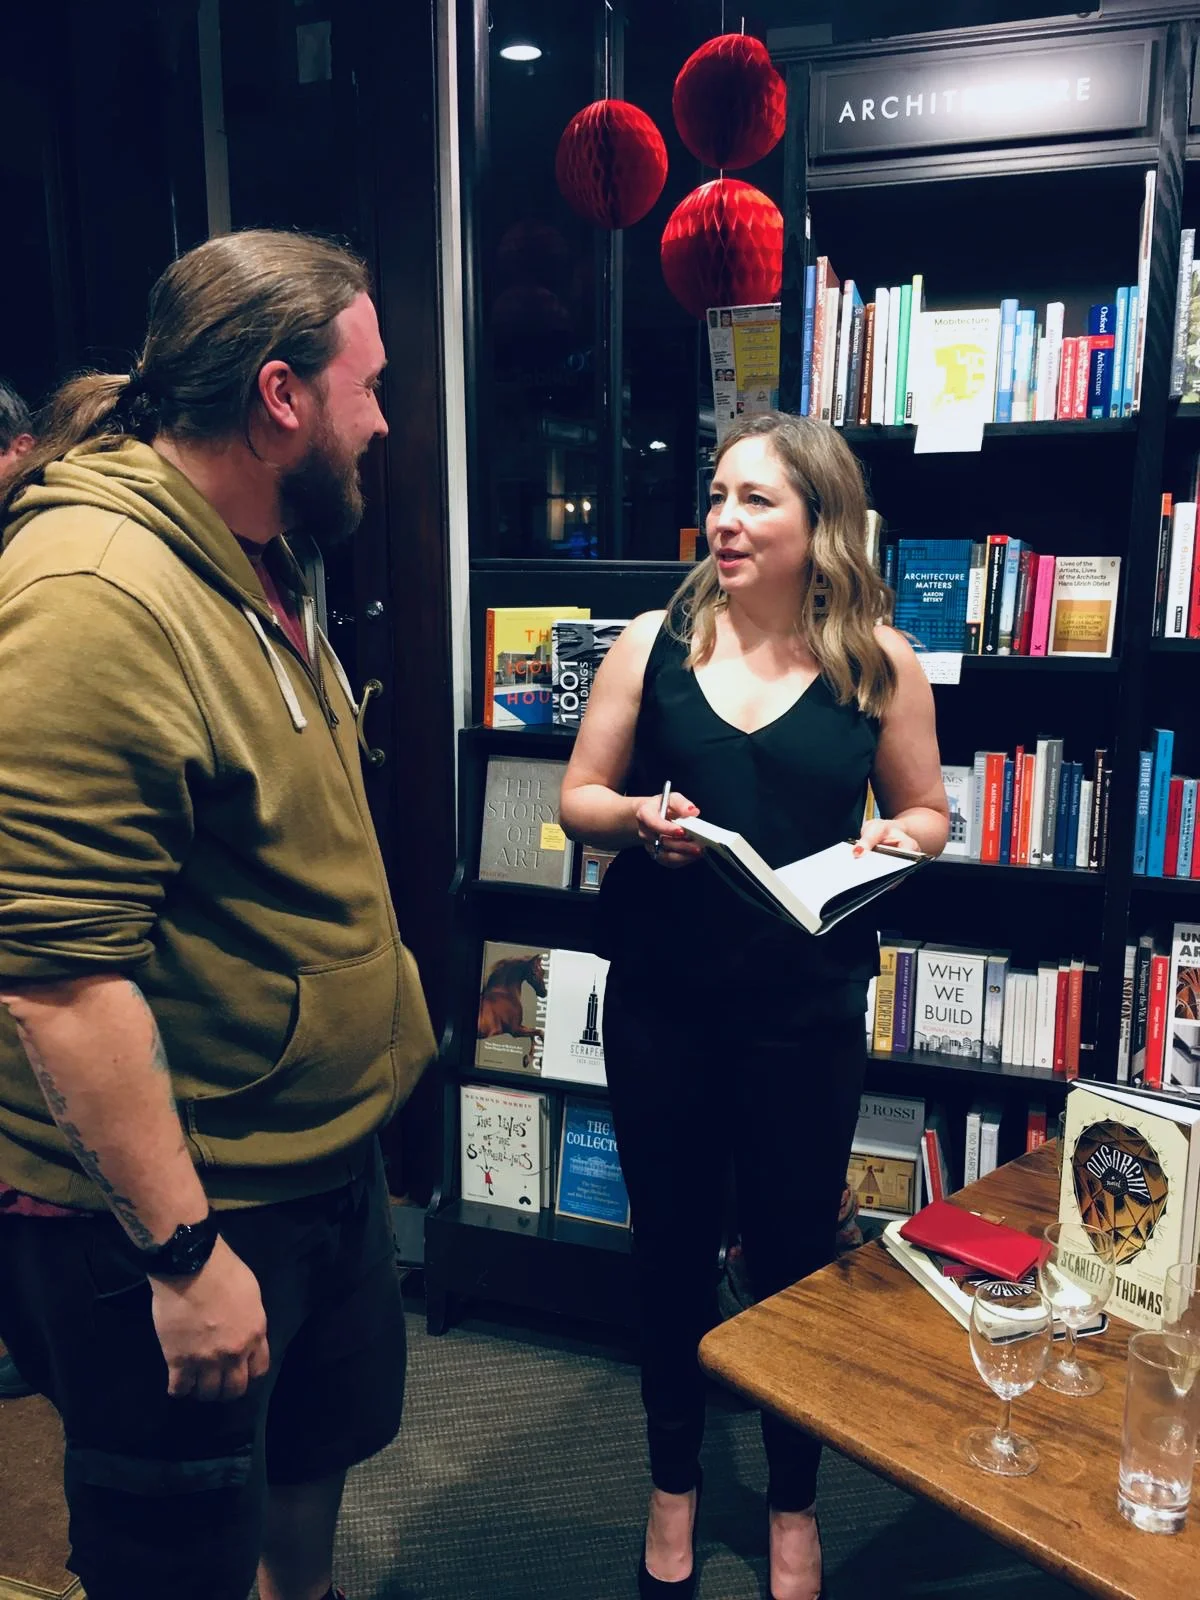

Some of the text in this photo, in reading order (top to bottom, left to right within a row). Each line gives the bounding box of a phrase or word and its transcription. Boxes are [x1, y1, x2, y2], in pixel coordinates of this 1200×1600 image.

[838, 77, 1091, 124] ARCHITE
[934, 317, 990, 326] Mobitecture
[1099, 306, 1109, 335] Oxford
[852, 317, 862, 354] architecture
[863, 360, 871, 394] ARCHITECTURE
[1095, 351, 1105, 396] Architecture
[904, 573, 965, 581] ARCHITECTURE
[915, 581, 953, 590] MATTERS
[971, 571, 981, 620] ARCHITECTURE
[525, 629, 550, 643] TH
[507, 690, 550, 705] HOU
[560, 661, 579, 723] 1001
[1140, 758, 1151, 787] FUTURE
[505, 778, 545, 800] THE
[1047, 767, 1058, 815] Architectural Styles
[487, 801, 560, 824] STORY
[1139, 790, 1150, 816] CITIES
[989, 804, 997, 832] EMOTIONS
[507, 823, 538, 845] OF
[495, 847, 544, 869] ART
[928, 962, 973, 983] WHY
[934, 985, 964, 1003] WE
[1121, 978, 1134, 1020] ISOKON
[1137, 960, 1149, 1023] Designing the V&A
[877, 989, 893, 1038] CONCRETOPIA
[925, 1005, 973, 1025] BUILD
[465, 1094, 500, 1104] DESMOND
[474, 1114, 492, 1128] THE
[873, 1103, 915, 1120] ROSSI
[587, 1119, 610, 1135] THE
[968, 1132, 976, 1144] 100
[566, 1131, 618, 1152] COLLECT
[967, 1147, 975, 1171] YEARS
[1086, 1144, 1151, 1199] OLIGARCHY
[1106, 1180, 1121, 1188] novel
[1060, 1250, 1106, 1285] SCARLETT
[1116, 1276, 1163, 1316] THOMAS
